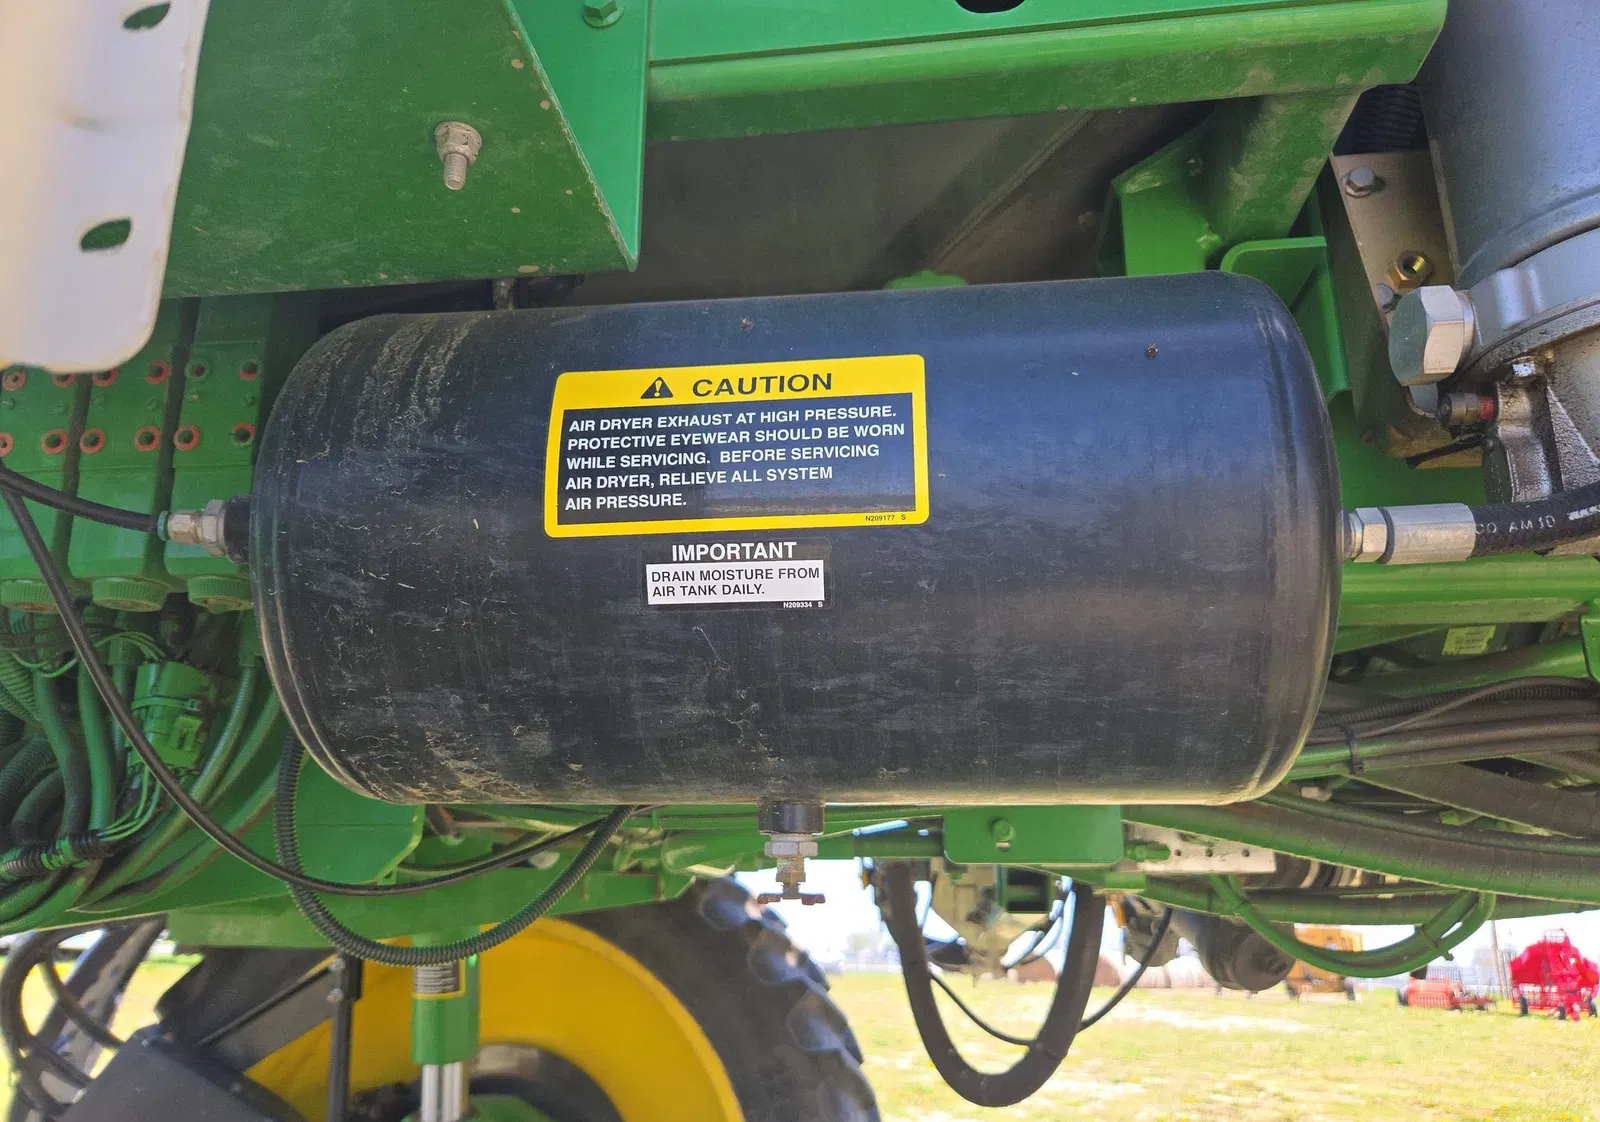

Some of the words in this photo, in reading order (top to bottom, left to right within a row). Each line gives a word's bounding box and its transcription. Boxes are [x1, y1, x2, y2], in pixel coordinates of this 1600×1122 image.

[692, 373, 832, 397] CAUTION
[569, 420, 595, 432] AIR
[600, 418, 652, 431] DRYER
[657, 413, 732, 428] EXHAUST
[736, 413, 756, 425] AT
[761, 410, 799, 423] HIGH
[805, 406, 896, 421] PRESSURE.
[568, 435, 665, 450] PROTECTIVE
[671, 432, 750, 446] EYEWEAR
[755, 427, 823, 442] SHOULD
[828, 426, 849, 439] BE
[854, 424, 904, 437] WORN
[567, 456, 616, 469] WHILE
[620, 451, 710, 467] SERVICING.
[721, 448, 786, 463] BEFORE
[791, 444, 879, 459] SERVICING
[566, 477, 592, 490] AIR
[596, 474, 654, 489] DRYER,
[659, 471, 726, 485] RELIEVE
[731, 469, 762, 482] ALL
[766, 467, 832, 481] SYSTEM
[565, 497, 591, 510] AIR
[596, 493, 686, 508] PRESSURE.
[865, 514, 895, 522] N209177
[672, 542, 797, 561] IMPORTANT
[652, 571, 695, 582] DRAIN
[700, 569, 773, 581] MOISTURE
[779, 568, 819, 579] FROM
[653, 586, 675, 597] AIR
[680, 585, 716, 596] TANK
[722, 584, 764, 595] DAILY.
